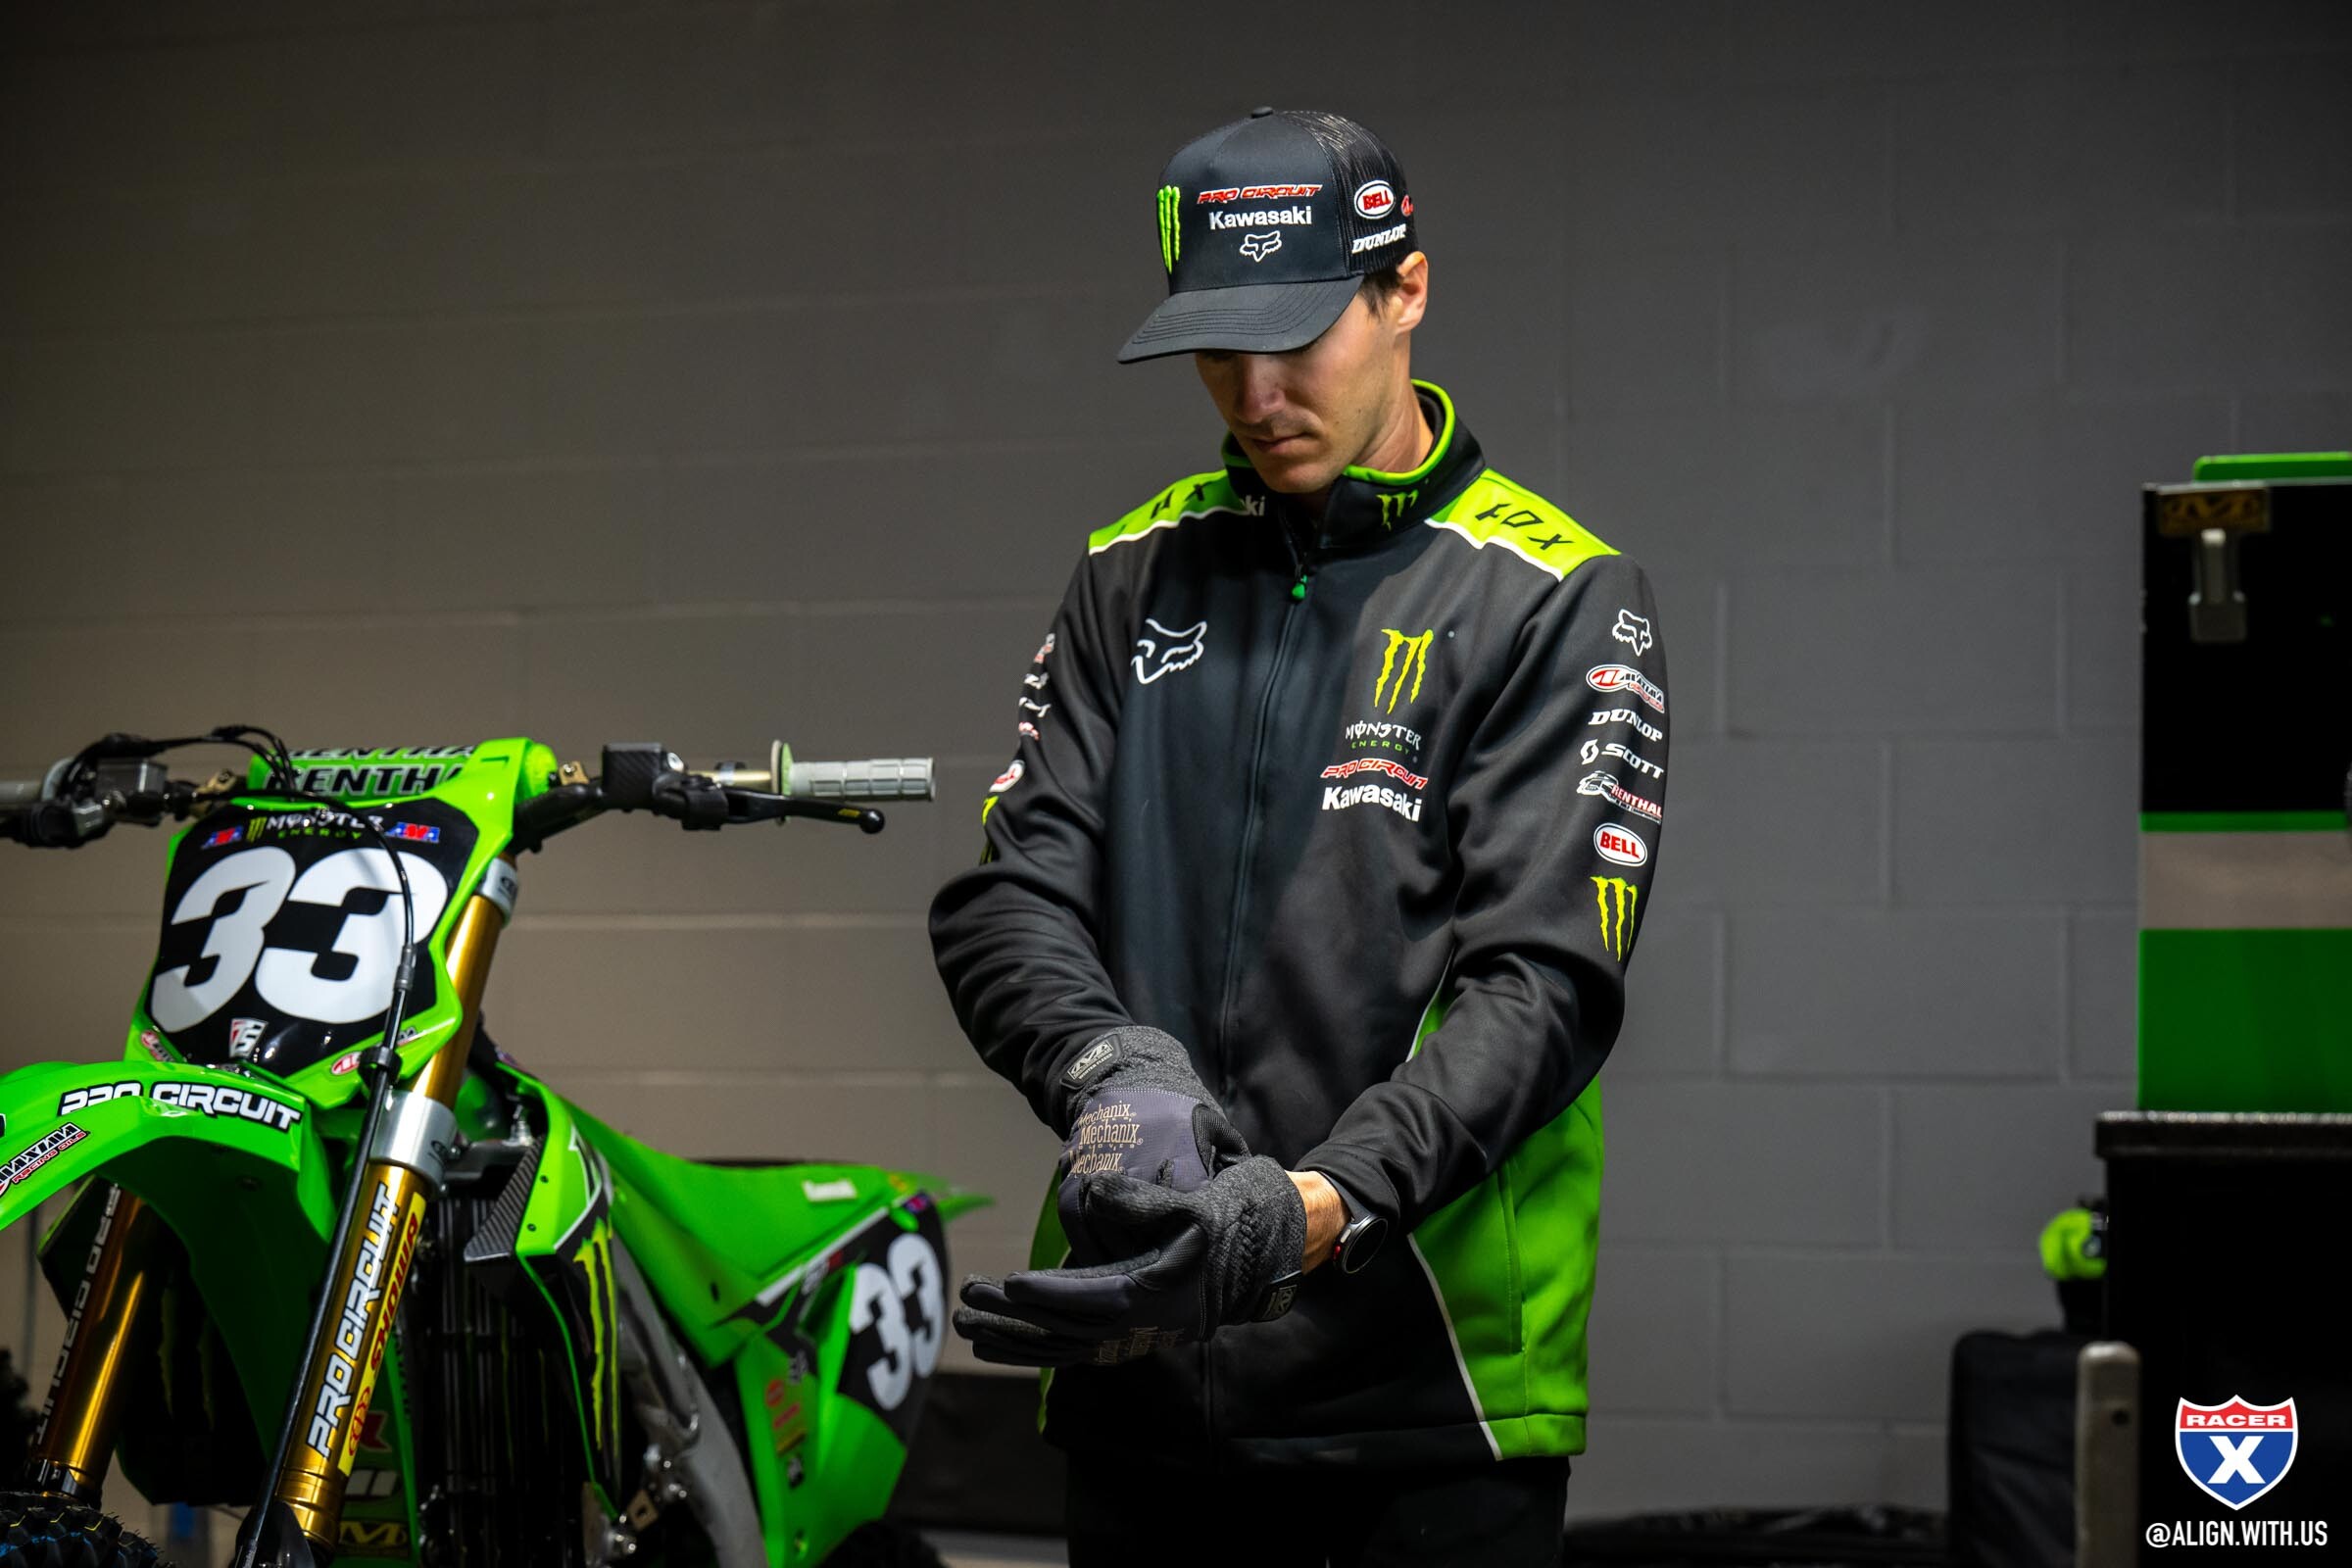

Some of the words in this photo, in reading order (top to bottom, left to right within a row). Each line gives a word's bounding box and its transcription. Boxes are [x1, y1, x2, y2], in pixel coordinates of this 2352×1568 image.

[1197, 187, 1240, 204] PRO
[1241, 183, 1323, 199] CIRCUIT
[1362, 189, 1392, 211] BELL
[1208, 205, 1312, 230] Kawasaki
[1351, 223, 1407, 255] DUNLOP
[1588, 709, 1663, 742] DUNLOP
[1350, 740, 1410, 756] ENERGY
[1601, 743, 1665, 779] SCOTT
[1320, 760, 1358, 779] PRO
[1356, 758, 1429, 790] CIRCUIT
[1321, 784, 1423, 822] Kawasaki
[1610, 784, 1663, 817] RENTHAL
[1599, 830, 1641, 859] BELL
[151, 846, 449, 1033] 33
[151, 1082, 301, 1132] CIRCUIT
[307, 1352, 356, 1460] PRO
[335, 1182, 400, 1360] CIRCUIT
[849, 1232, 944, 1411] 33
